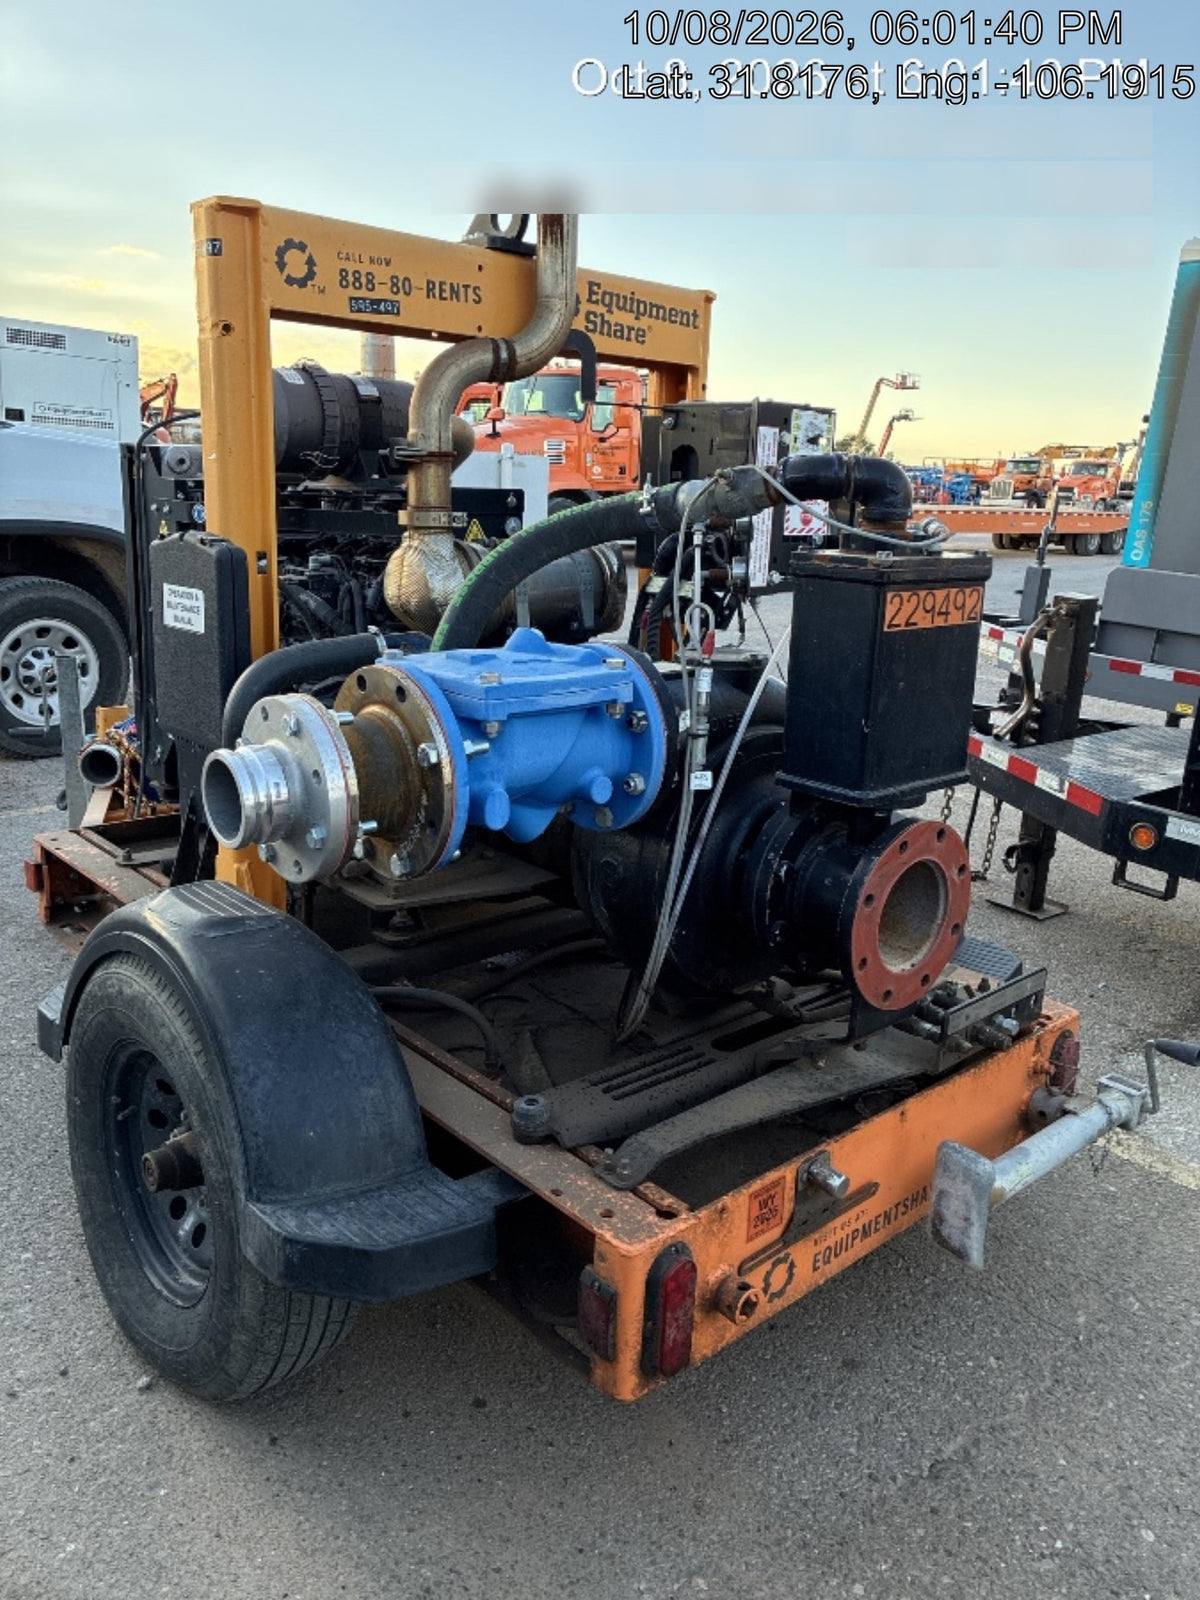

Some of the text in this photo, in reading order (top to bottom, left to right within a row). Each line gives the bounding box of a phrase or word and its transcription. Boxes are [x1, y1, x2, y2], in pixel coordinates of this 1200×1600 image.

[337, 251, 392, 267] CALL NOW
[338, 268, 483, 305] 888-80-RENTS
[586, 280, 700, 329] Equipment
[887, 588, 980, 630] 229492
[812, 1181, 933, 1273] EQUIPMENTSHA
